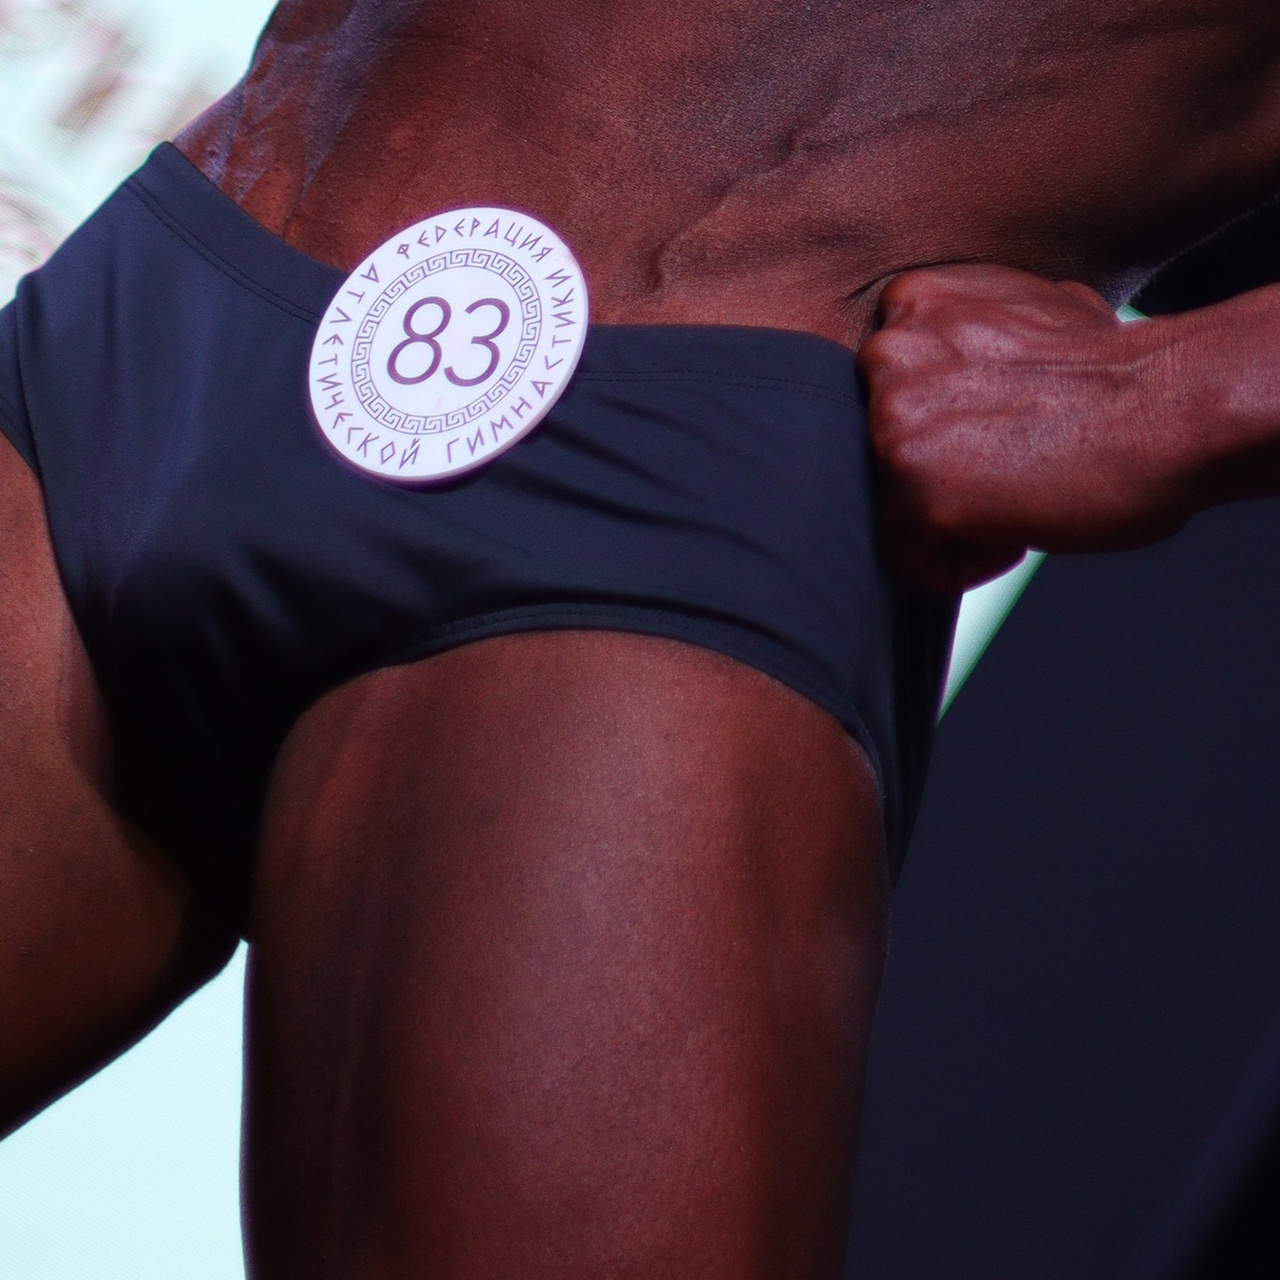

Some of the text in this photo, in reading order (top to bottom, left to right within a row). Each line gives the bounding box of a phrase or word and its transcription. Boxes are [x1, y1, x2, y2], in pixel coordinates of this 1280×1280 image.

[396, 217, 553, 262] ФЕДЕРАЦИЯ
[315, 262, 577, 469] АТЛЕТИЧЕСКОЙ ГИМНАСТИКИ
[386, 295, 511, 387] 83
